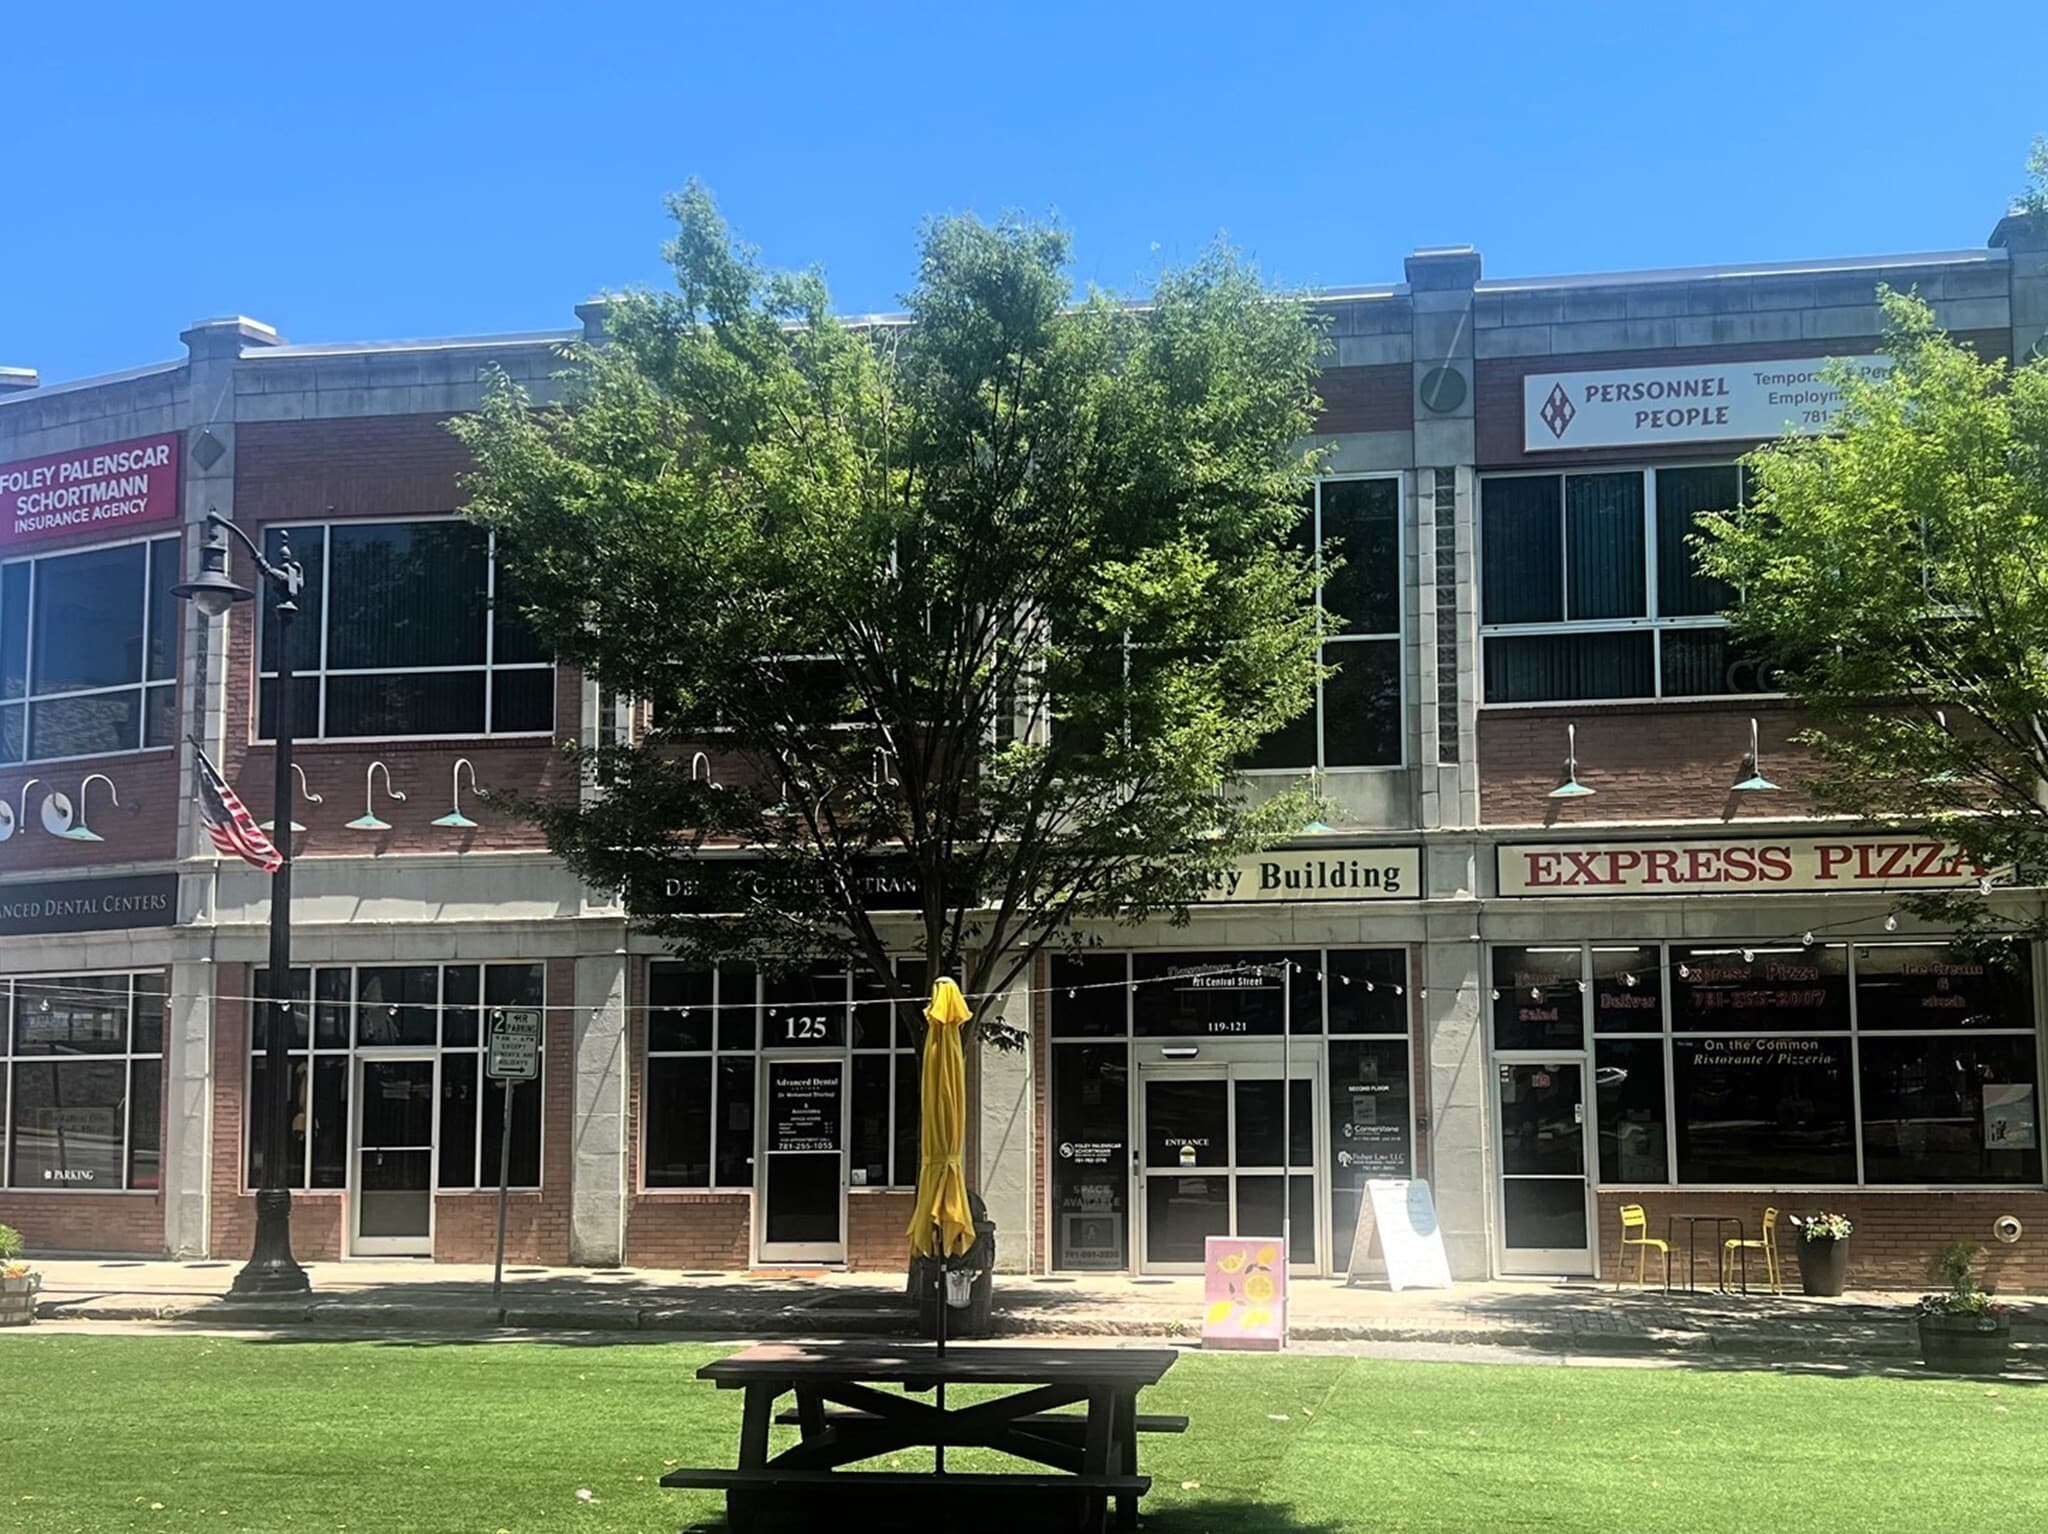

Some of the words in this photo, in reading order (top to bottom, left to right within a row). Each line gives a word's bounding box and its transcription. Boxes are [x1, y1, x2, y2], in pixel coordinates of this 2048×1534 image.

[1584, 377, 1729, 404] PERSONNEL
[1753, 371, 1823, 387] Tempor
[1635, 405, 1729, 430] PEOPLE
[0, 465, 56, 495] FOLEY
[60, 445, 169, 484] PALENSCAR
[16, 474, 148, 516] SCHORTMANN
[15, 508, 89, 534] INSURANCE
[92, 498, 148, 521] AGENCY
[1259, 860, 1401, 891] Building
[1524, 846, 1793, 887] EXPRESS
[1814, 842, 1990, 880] PIZZA
[45, 898, 98, 916] DENTAL
[103, 893, 167, 913] CENTERS
[1205, 977, 1235, 987] Central
[1238, 977, 1262, 986] Street
[493, 1010, 505, 1033] 2
[785, 1016, 827, 1039] 125
[1208, 1021, 1247, 1032] 119-121
[1704, 1039, 1724, 1051] On
[1729, 1039, 1751, 1051] the
[1756, 1039, 1819, 1051] Common
[1693, 1053, 1763, 1066] Ristorante
[1777, 1053, 1832, 1066] Pizzeria
[813, 1077, 839, 1087] Dental
[1354, 1124, 1399, 1133] Cornerstone
[1165, 1138, 1209, 1147] ENTRANCE
[54, 1169, 94, 1181] PARKING
